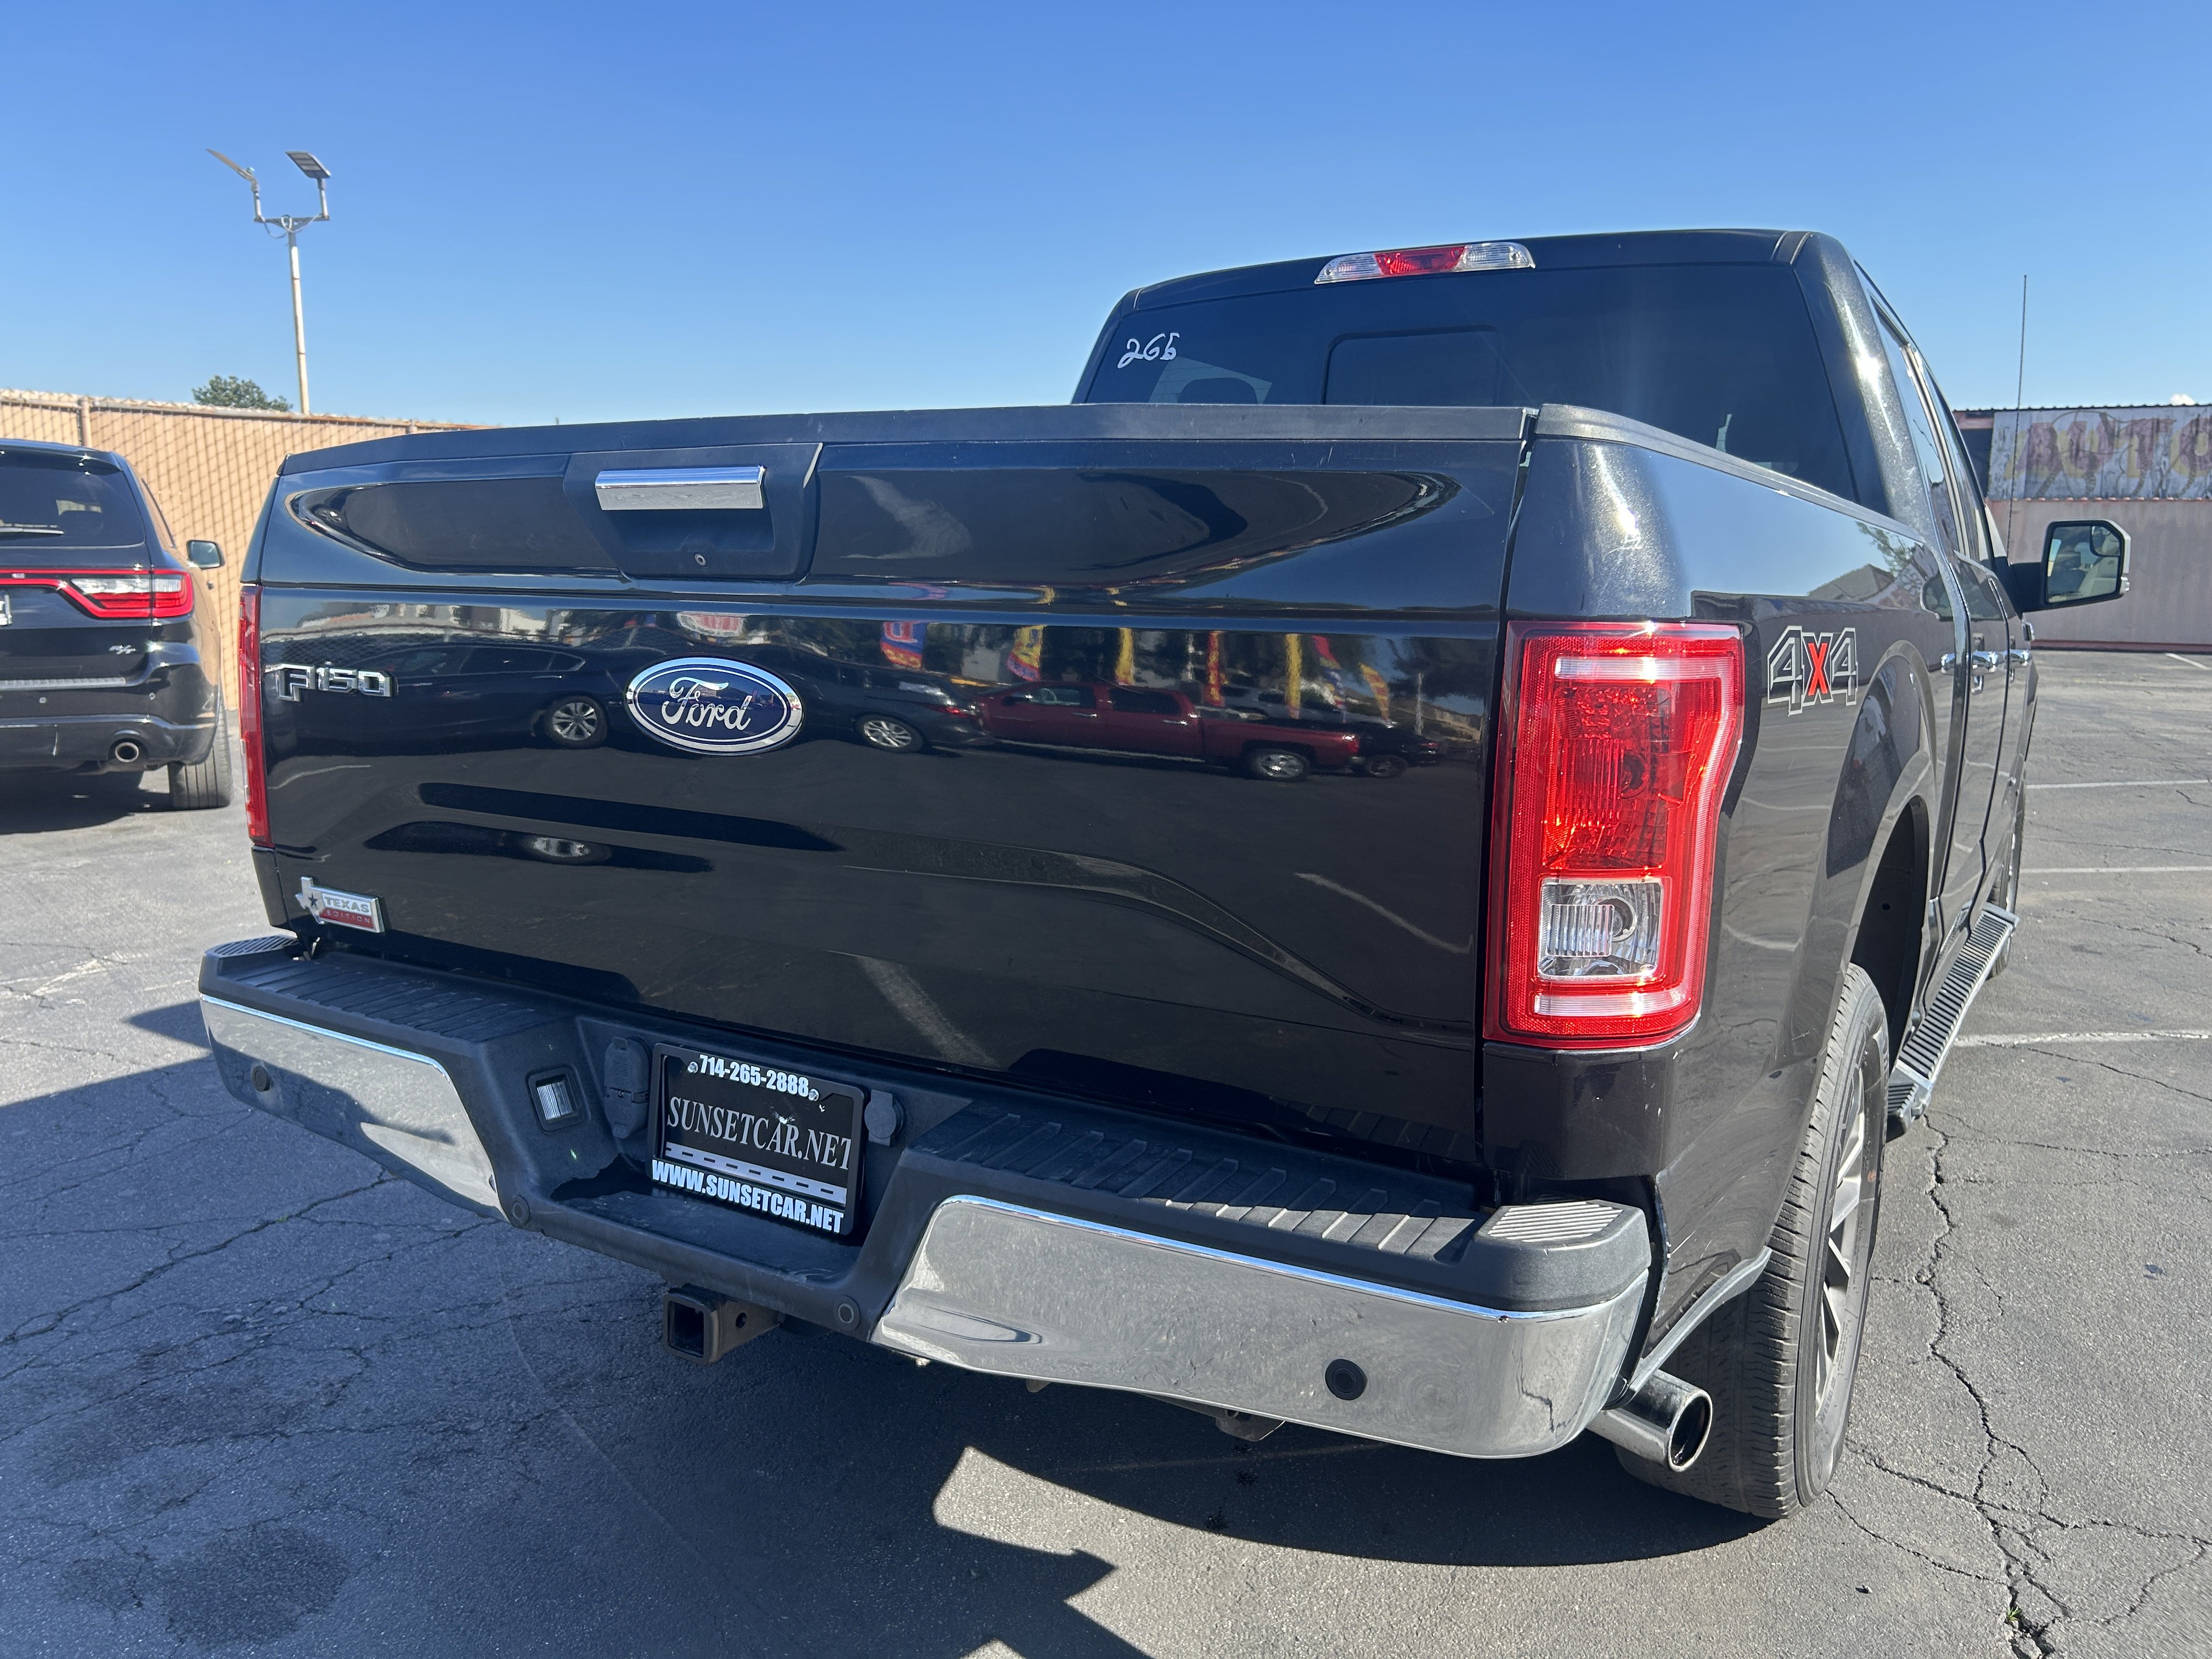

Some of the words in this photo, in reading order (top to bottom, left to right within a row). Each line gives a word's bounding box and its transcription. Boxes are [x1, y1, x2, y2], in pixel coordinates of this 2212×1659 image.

[661, 676, 752, 731] Ford
[324, 896, 370, 913] TEXAS
[325, 910, 371, 924] EDITION
[699, 1054, 809, 1098] 714-265-2888
[667, 1096, 851, 1170] SUNSETCAR.NET
[652, 1159, 844, 1233] WWW.SUNSETCAR.NET
